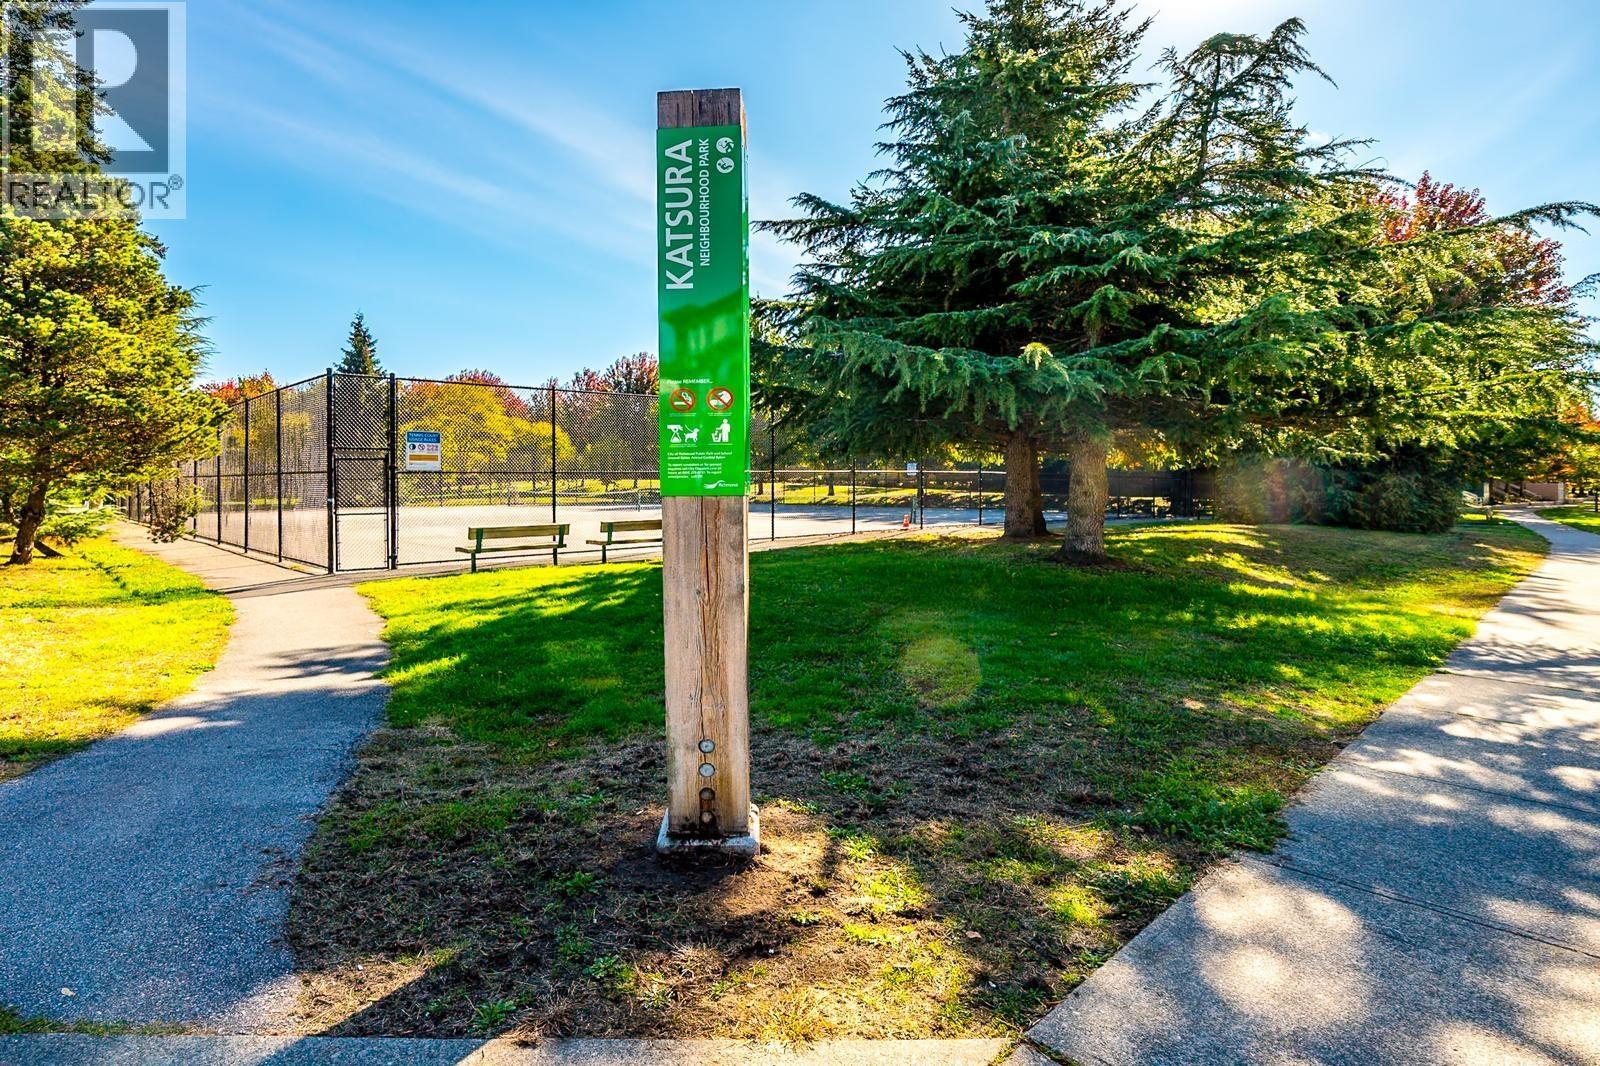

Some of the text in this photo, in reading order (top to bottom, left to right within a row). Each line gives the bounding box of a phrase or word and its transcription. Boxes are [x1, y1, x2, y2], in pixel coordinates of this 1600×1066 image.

[664, 139, 694, 290] KATSURA
[698, 138, 711, 266] NEIGHBOURHOOD PARK
